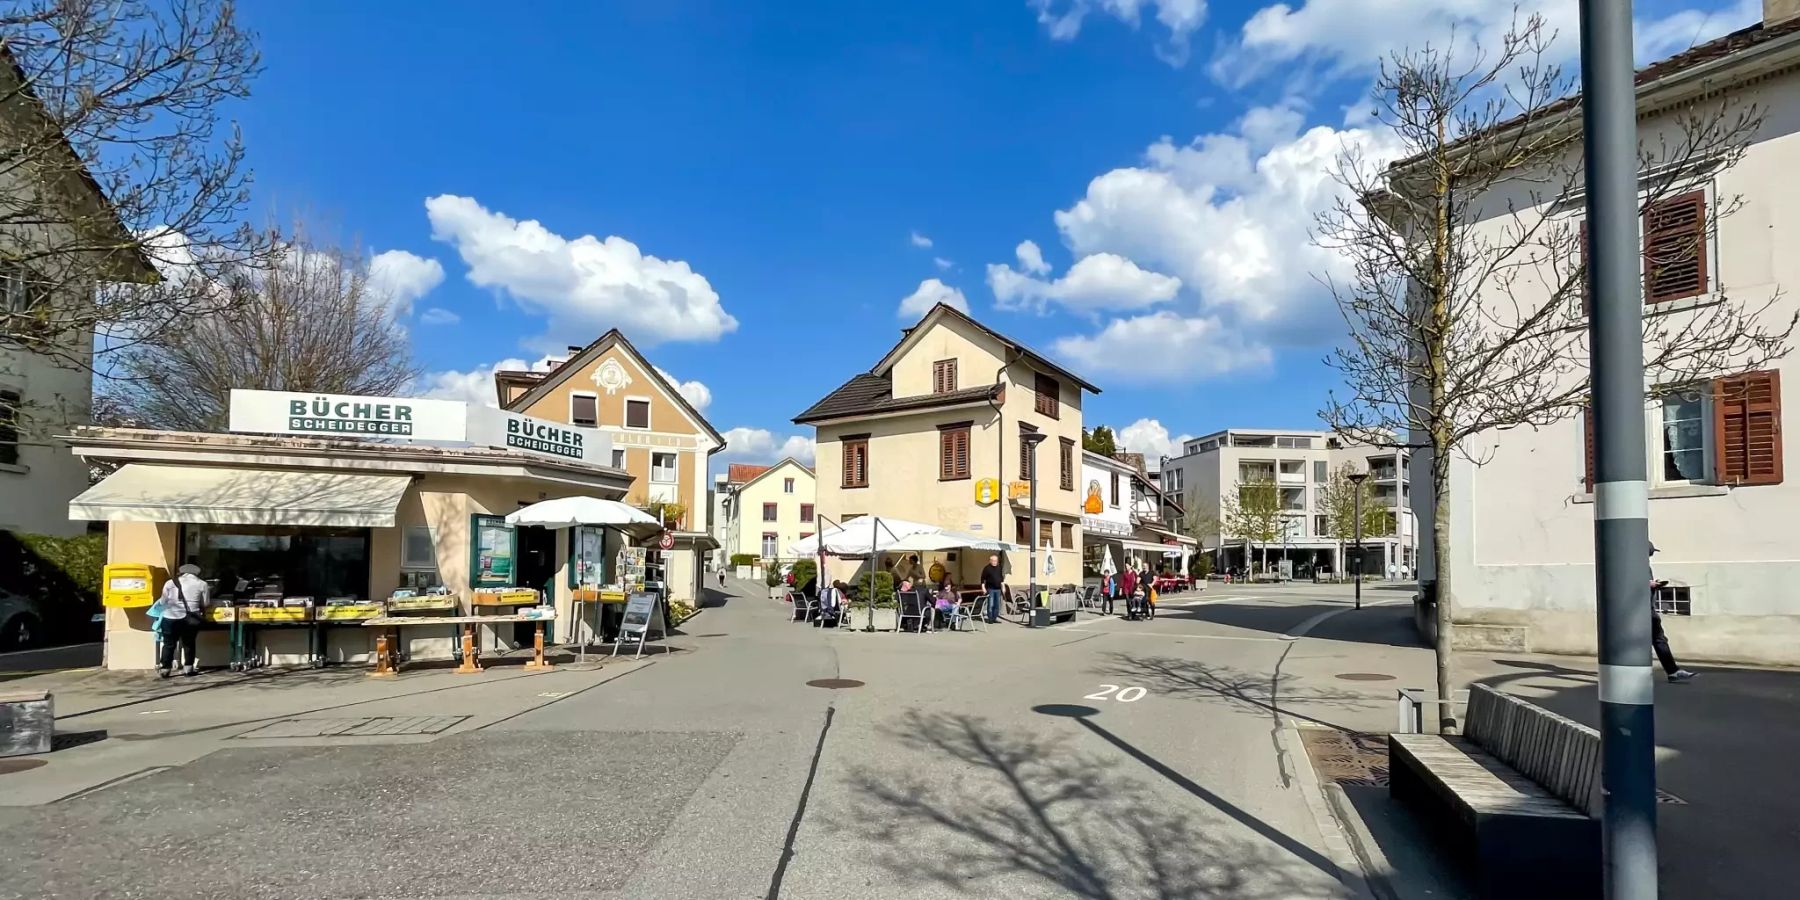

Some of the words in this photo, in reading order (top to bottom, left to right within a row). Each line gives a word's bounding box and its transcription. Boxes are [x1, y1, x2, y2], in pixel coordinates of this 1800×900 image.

[289, 396, 413, 421] BÜCHER
[291, 418, 411, 433] SCHEIDEGGER
[507, 418, 583, 447] BÜCHER
[508, 435, 582, 457] SCHEIDEGGER
[1083, 684, 1148, 703] 20
